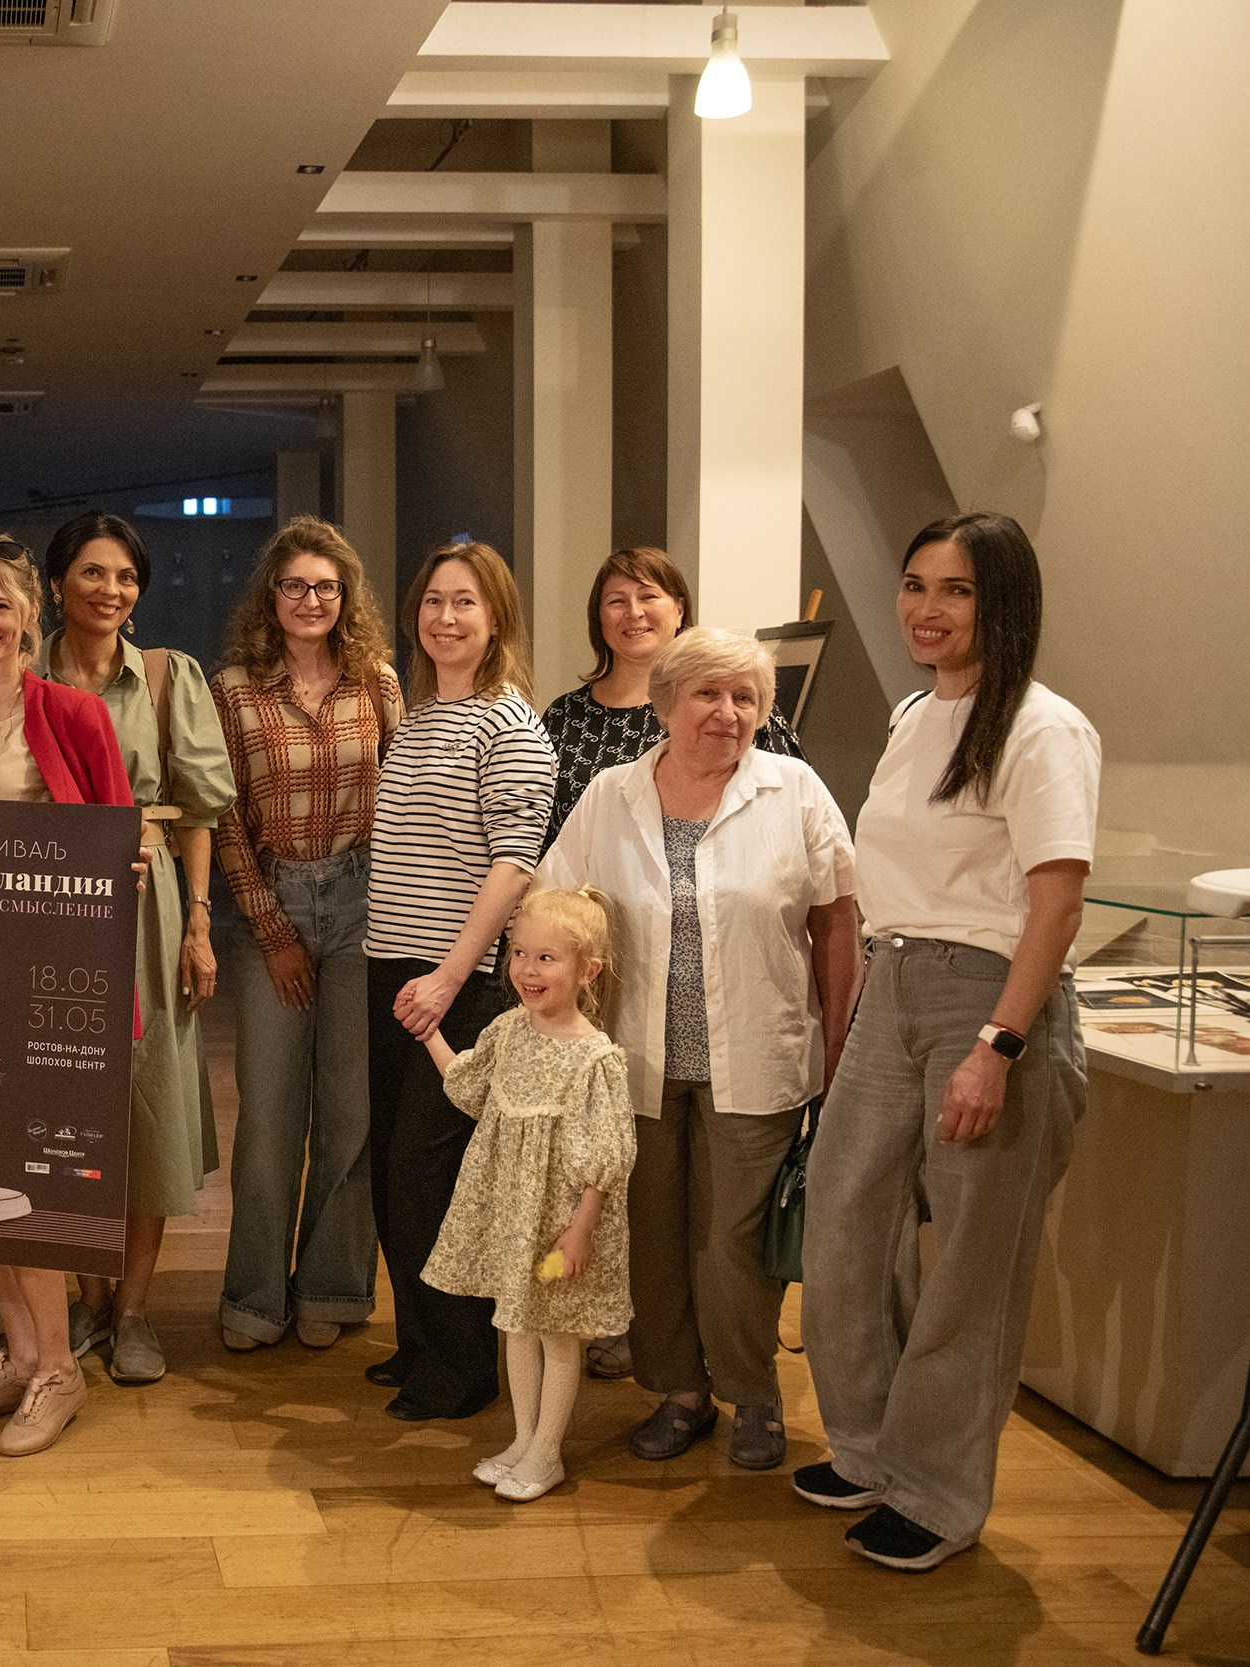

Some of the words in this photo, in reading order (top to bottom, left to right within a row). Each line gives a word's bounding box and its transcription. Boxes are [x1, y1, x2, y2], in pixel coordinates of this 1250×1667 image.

[29, 965, 108, 995] 18.05
[27, 1003, 106, 1034] 31.05
[27, 1041, 106, 1056] РОСТОВ-НА-ДОНУ
[26, 1056, 72, 1068] ШОЛОХОВ
[75, 1060, 106, 1071] ЦЕНТР
